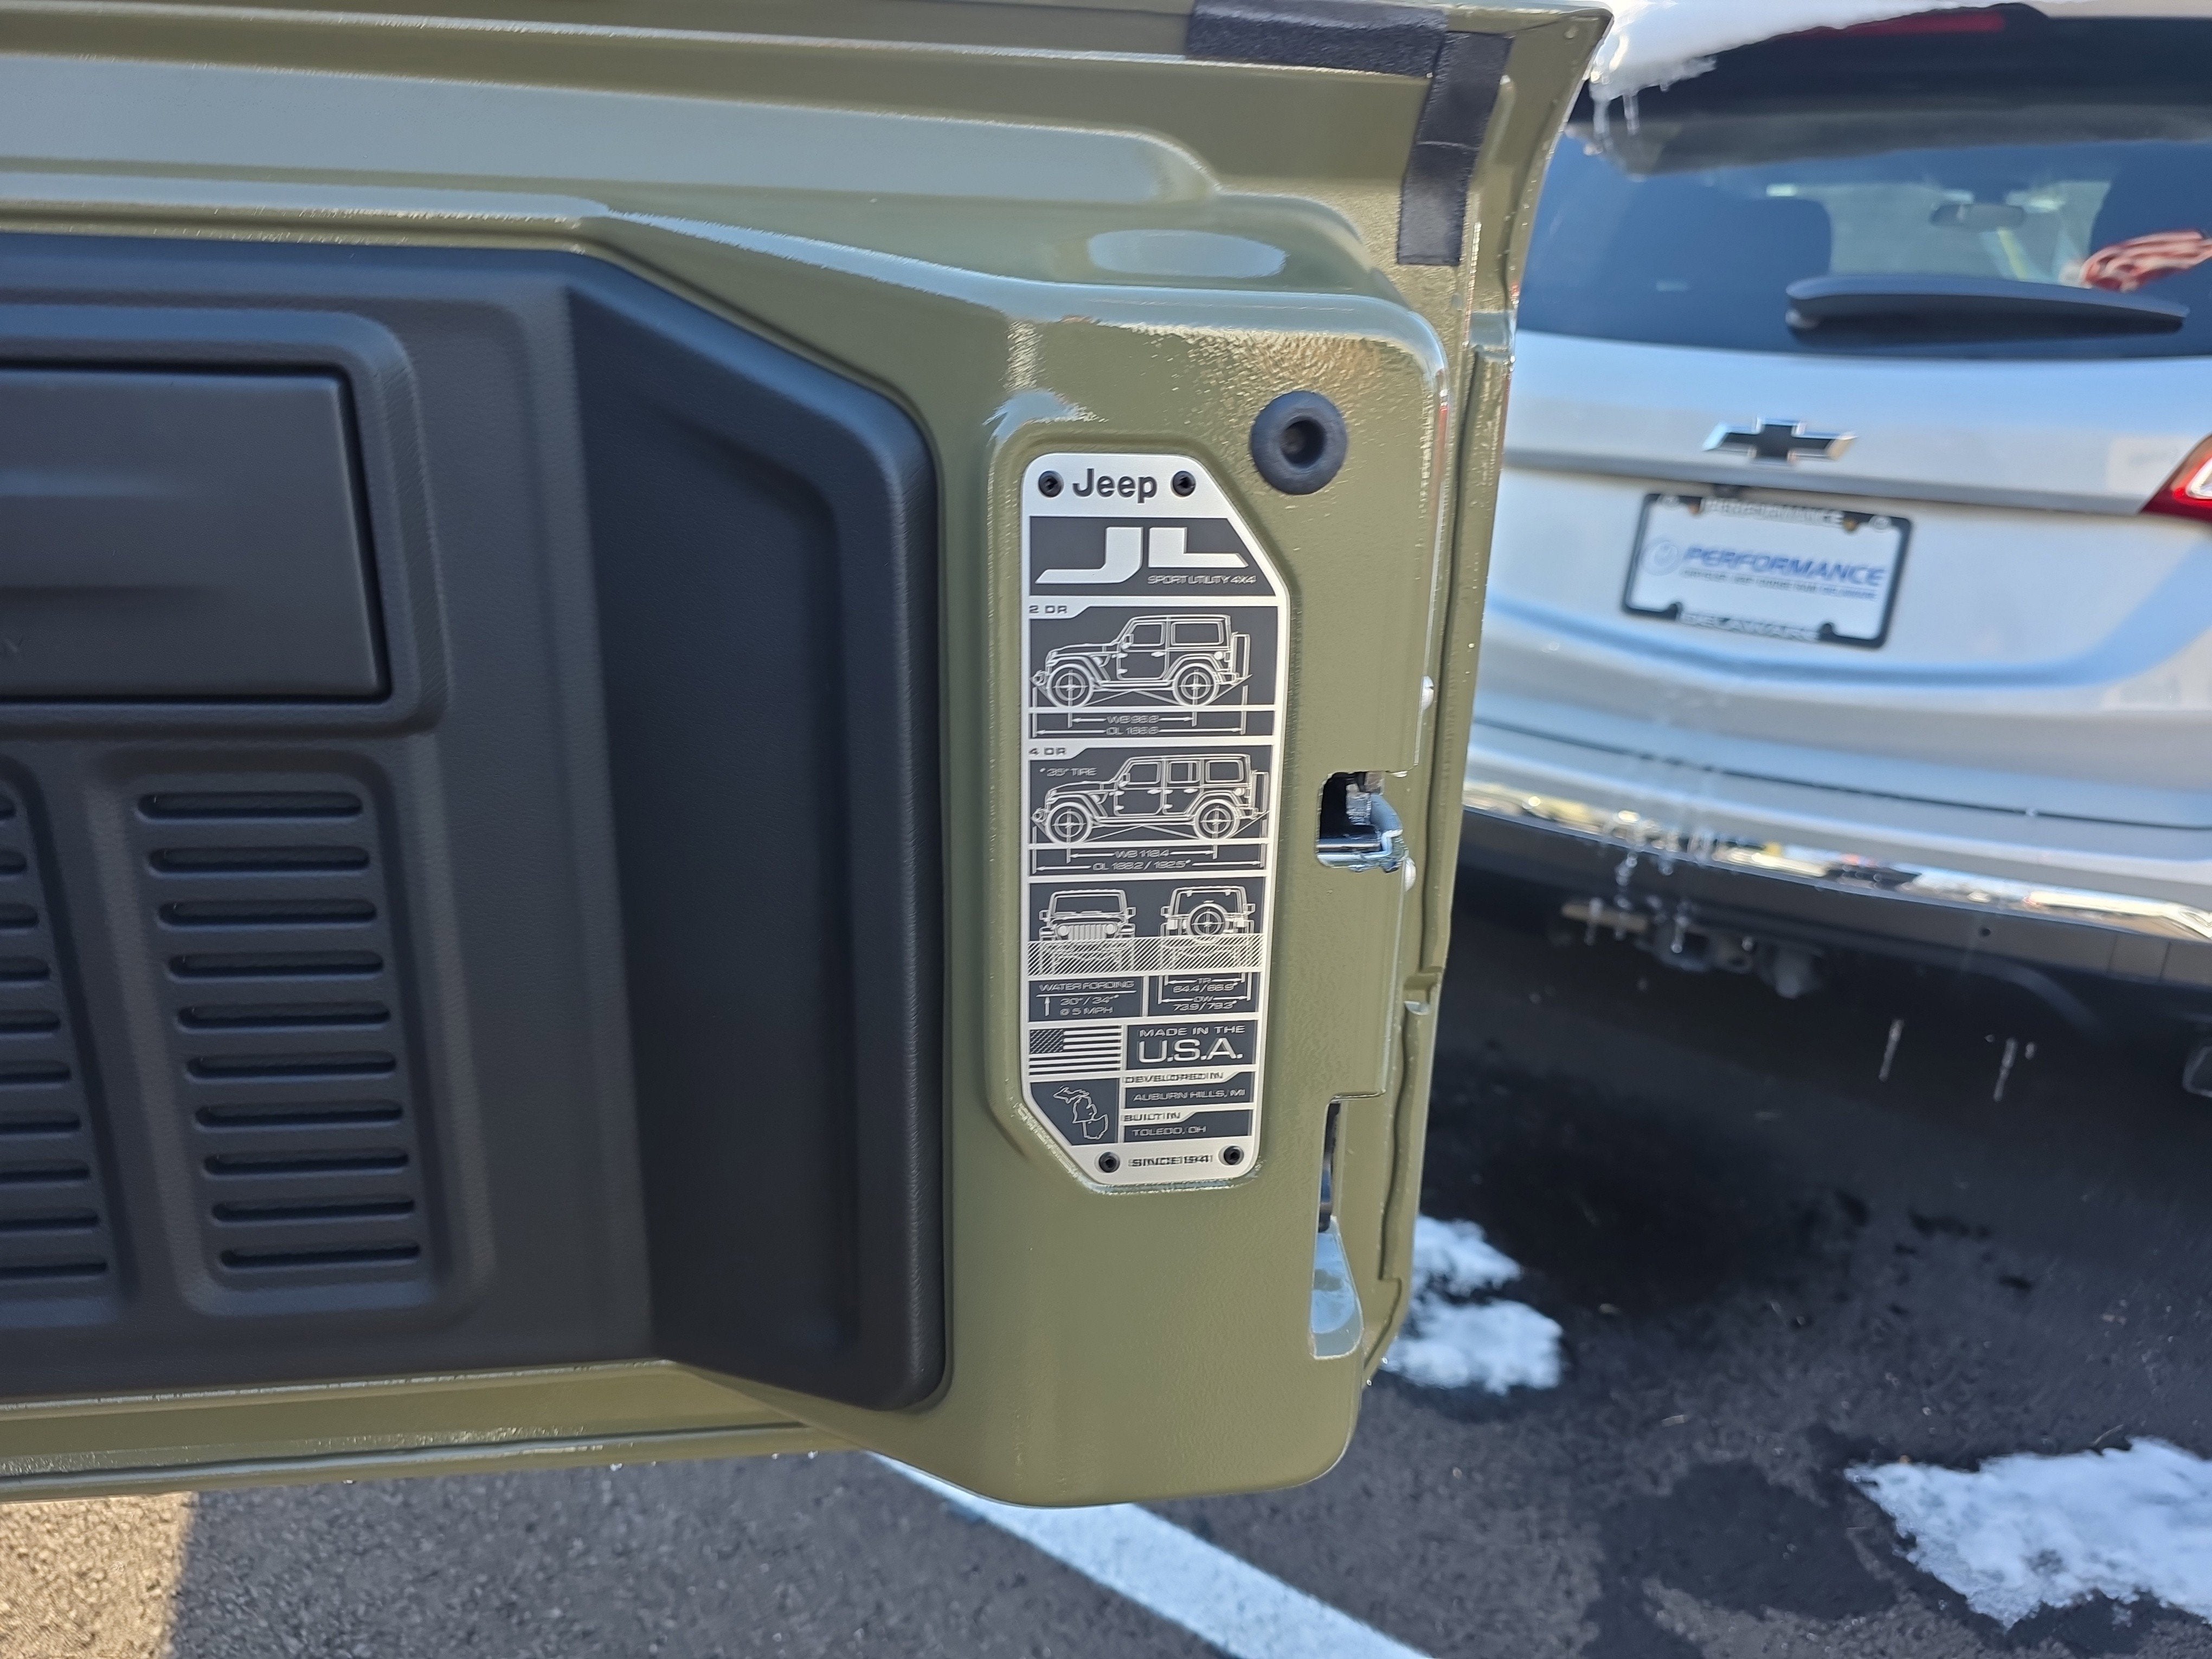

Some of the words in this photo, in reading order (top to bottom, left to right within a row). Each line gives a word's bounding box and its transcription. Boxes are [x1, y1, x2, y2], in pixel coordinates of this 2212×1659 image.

[1072, 468, 1158, 504] Jeep
[1035, 526, 1248, 584] JL
[1683, 547, 1886, 587] PERFORMANCE
[1147, 575, 1189, 584] SPORT
[1188, 575, 1231, 584] UTILITY
[1028, 605, 1039, 613] 2
[1045, 605, 1067, 613] DR
[1044, 747, 1066, 755] DR
[1114, 850, 1137, 858] WB
[1039, 982, 1082, 992] WATER
[1082, 980, 1135, 991] FORDING
[1071, 1007, 1082, 1016] 5
[1083, 1006, 1113, 1015] MPH
[1139, 1027, 1188, 1037] MADE
[1192, 1026, 1209, 1035] IN
[1213, 1025, 1246, 1034] THE
[1137, 1037, 1244, 1064] U.S.A.
[1124, 1073, 1206, 1084] DEVELOPED
[1133, 1091, 1188, 1102] AUBURN
[1189, 1090, 1227, 1098] HILLS,
[1230, 1089, 1246, 1097] MI
[1123, 1113, 1162, 1122] BUILT
[1131, 1127, 1186, 1136] TOLEDO,
[1131, 1156, 1182, 1167] SINCE
